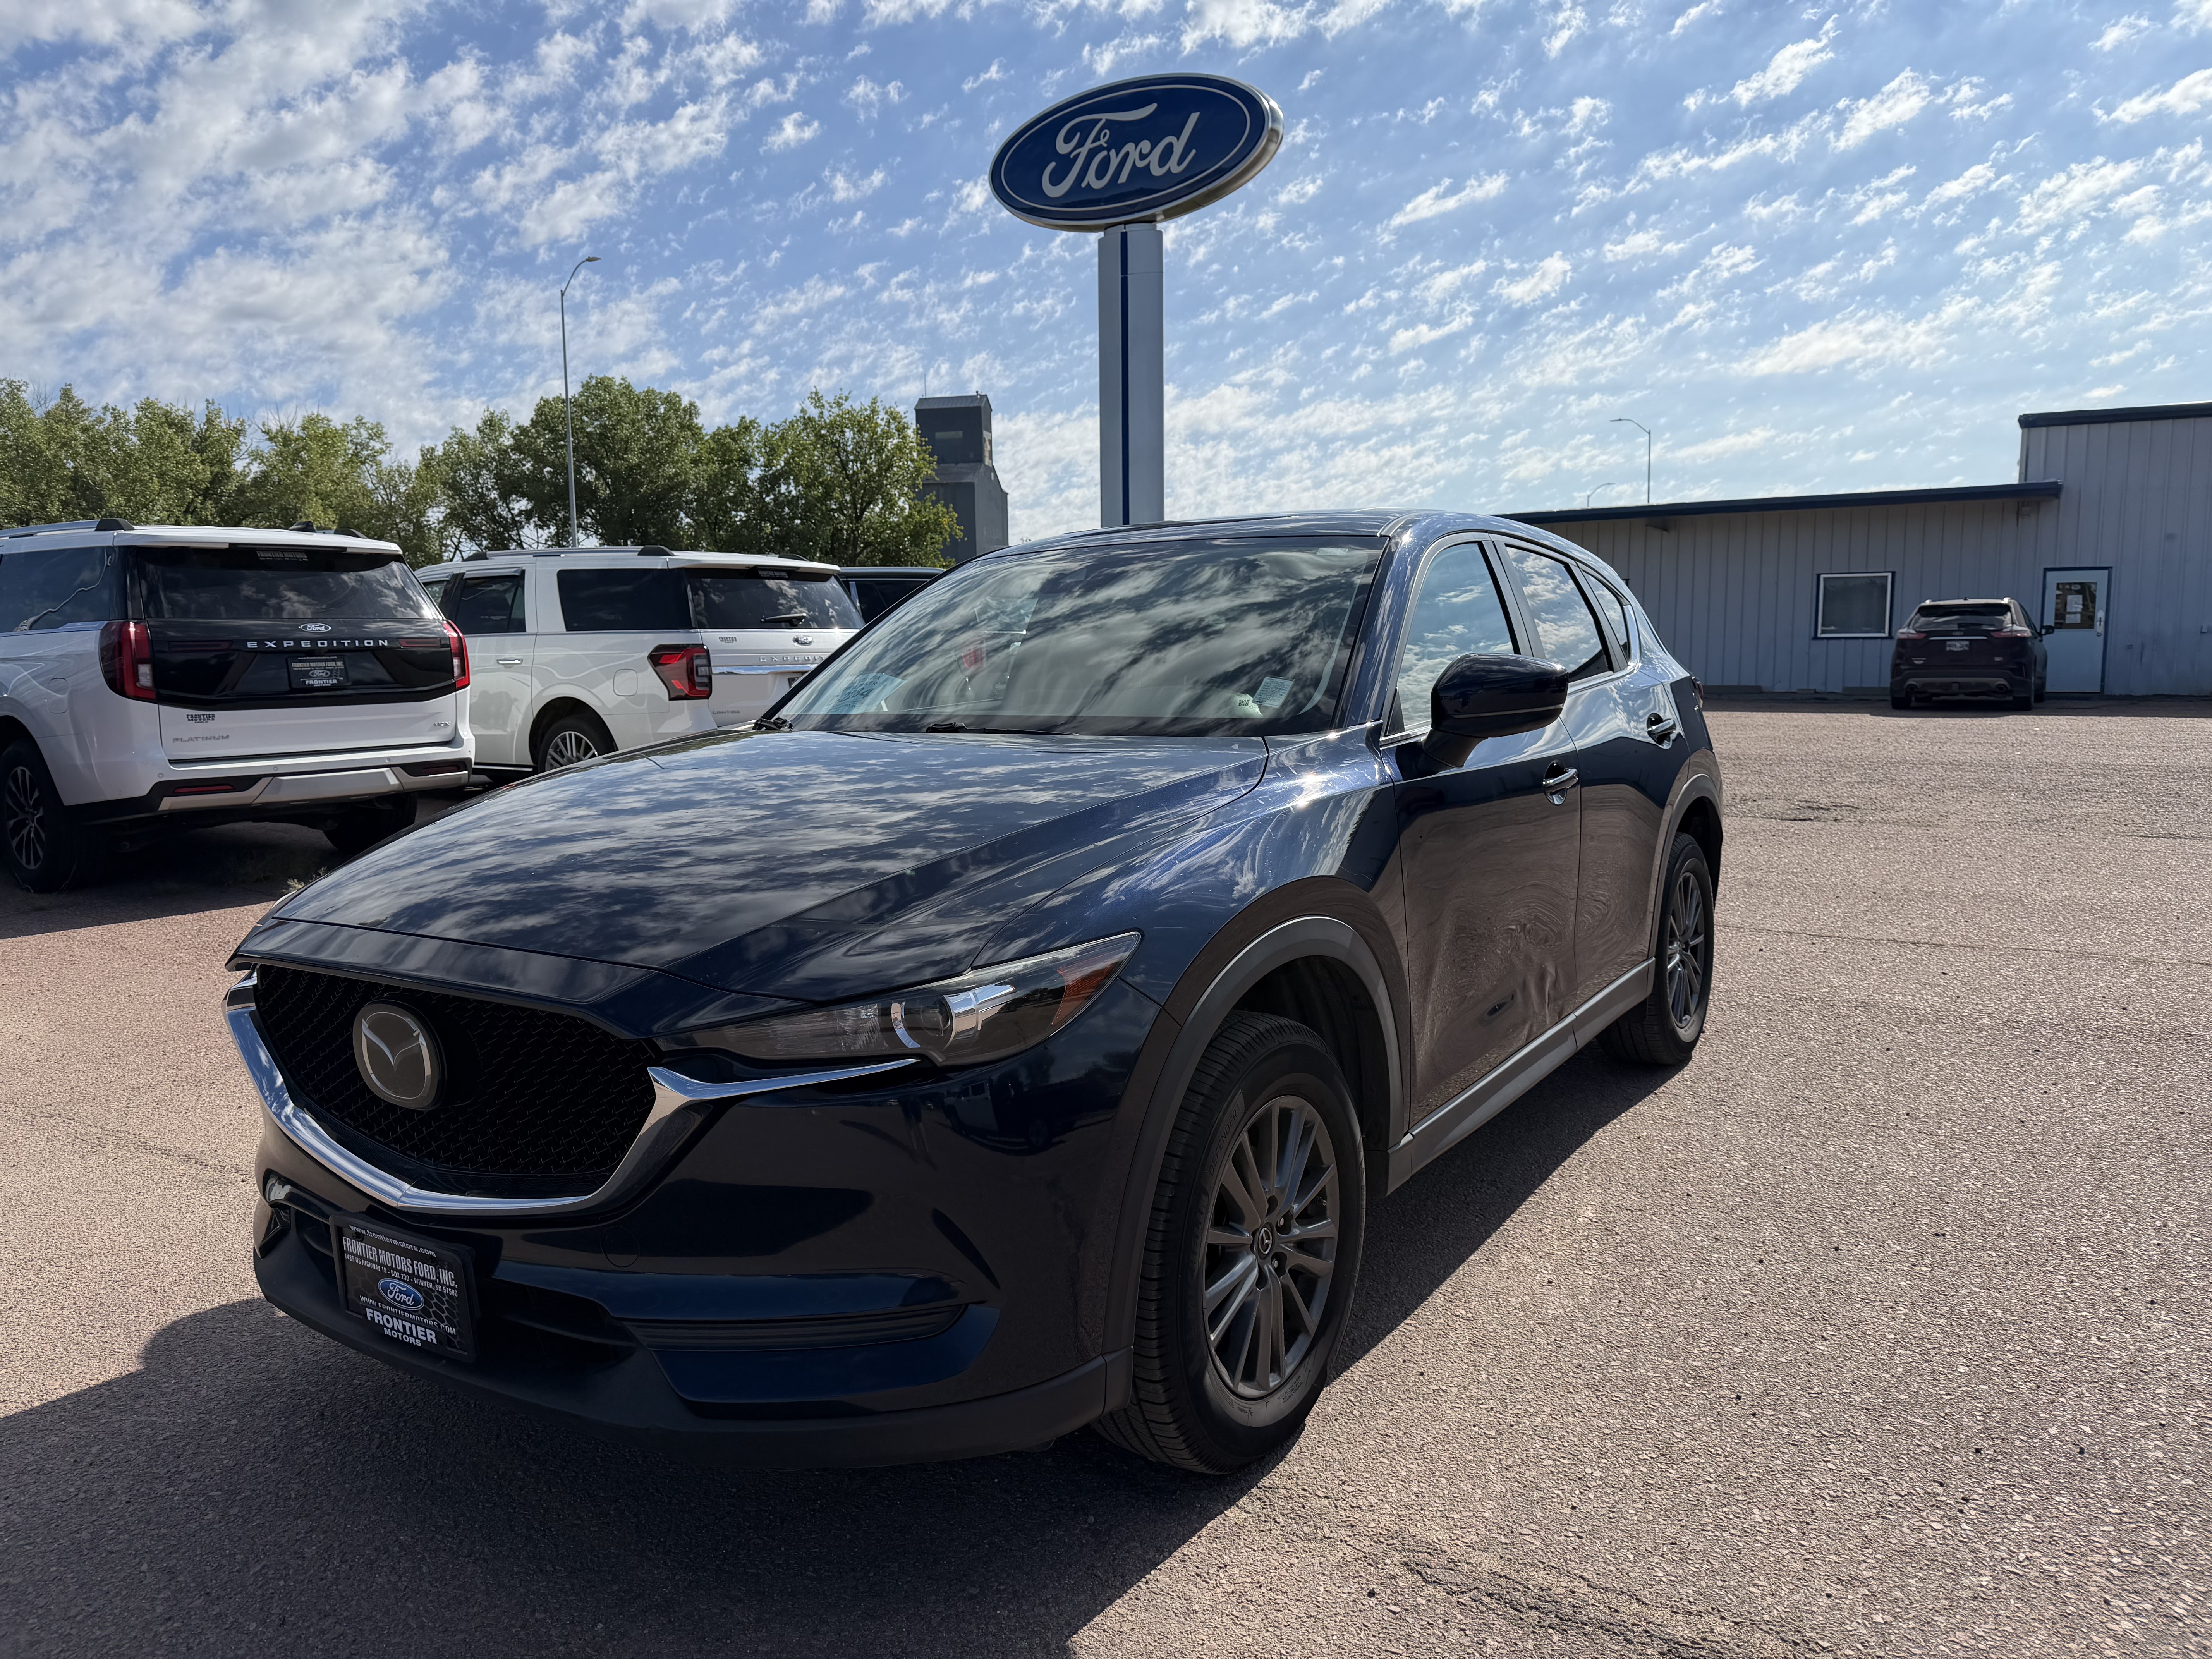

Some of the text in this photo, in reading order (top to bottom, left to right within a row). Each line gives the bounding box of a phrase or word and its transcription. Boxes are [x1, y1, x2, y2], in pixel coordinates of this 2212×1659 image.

[1042, 103, 1200, 198] Ford
[247, 640, 388, 648] EXPEDITION
[173, 735, 229, 743] PLATINUM
[349, 1225, 436, 1258] www.frontiermotors.com
[343, 1236, 458, 1288] FRONTIER MOTORS FORD, INC.
[362, 1260, 380, 1271] HIGHWAY
[391, 1269, 400, 1279] BOX
[401, 1273, 409, 1282] 230
[435, 1284, 442, 1292] SD
[443, 1286, 458, 1297] 57580
[387, 1282, 414, 1306] Ford
[366, 1307, 437, 1345] FRONTIER
[384, 1328, 422, 1347] MOTORS
